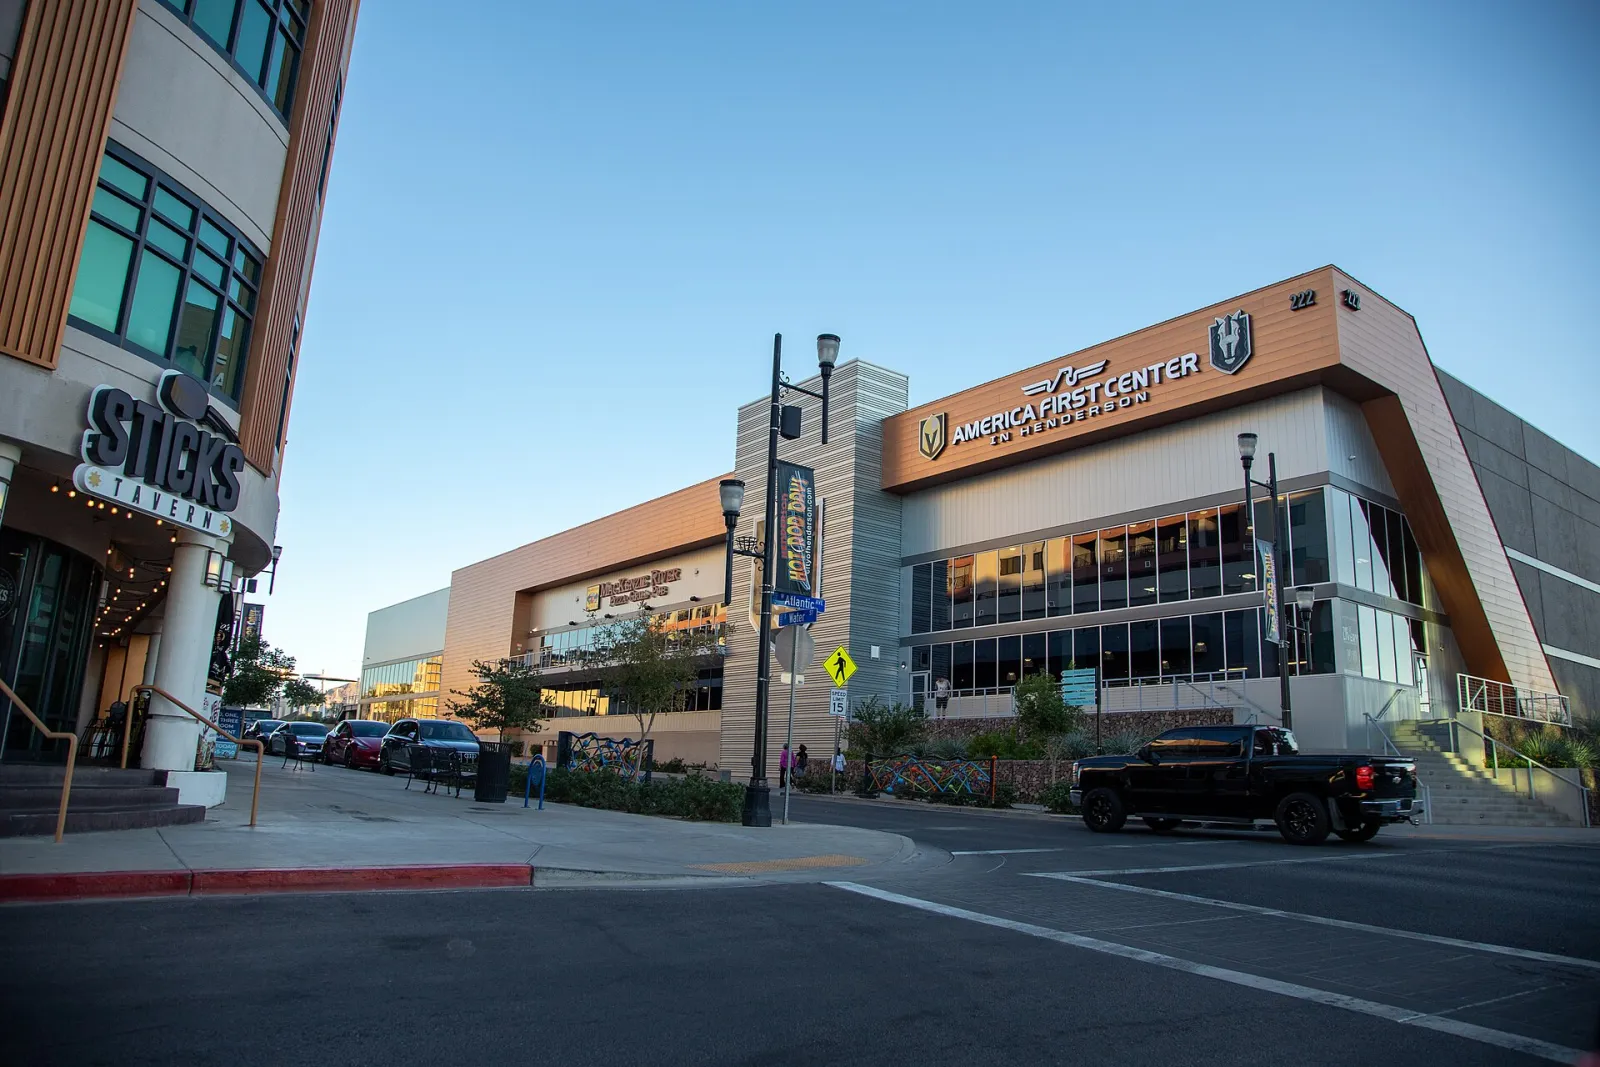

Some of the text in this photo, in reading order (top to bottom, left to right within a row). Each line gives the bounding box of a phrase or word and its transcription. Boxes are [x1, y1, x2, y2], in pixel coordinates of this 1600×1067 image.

[1290, 289, 1315, 311] 222
[952, 352, 1199, 445] AMERICA FIRST CENTER
[989, 391, 1148, 445] IN HENDERSON
[92, 388, 244, 512] STICKS
[113, 477, 212, 529] TAVERN
[787, 515, 805, 551] ROD
[805, 487, 813, 575] cityofhenderson.com
[787, 550, 807, 582] HOT
[785, 595, 815, 609] Atlantic
[789, 613, 805, 623] Water
[833, 702, 844, 713] 15
